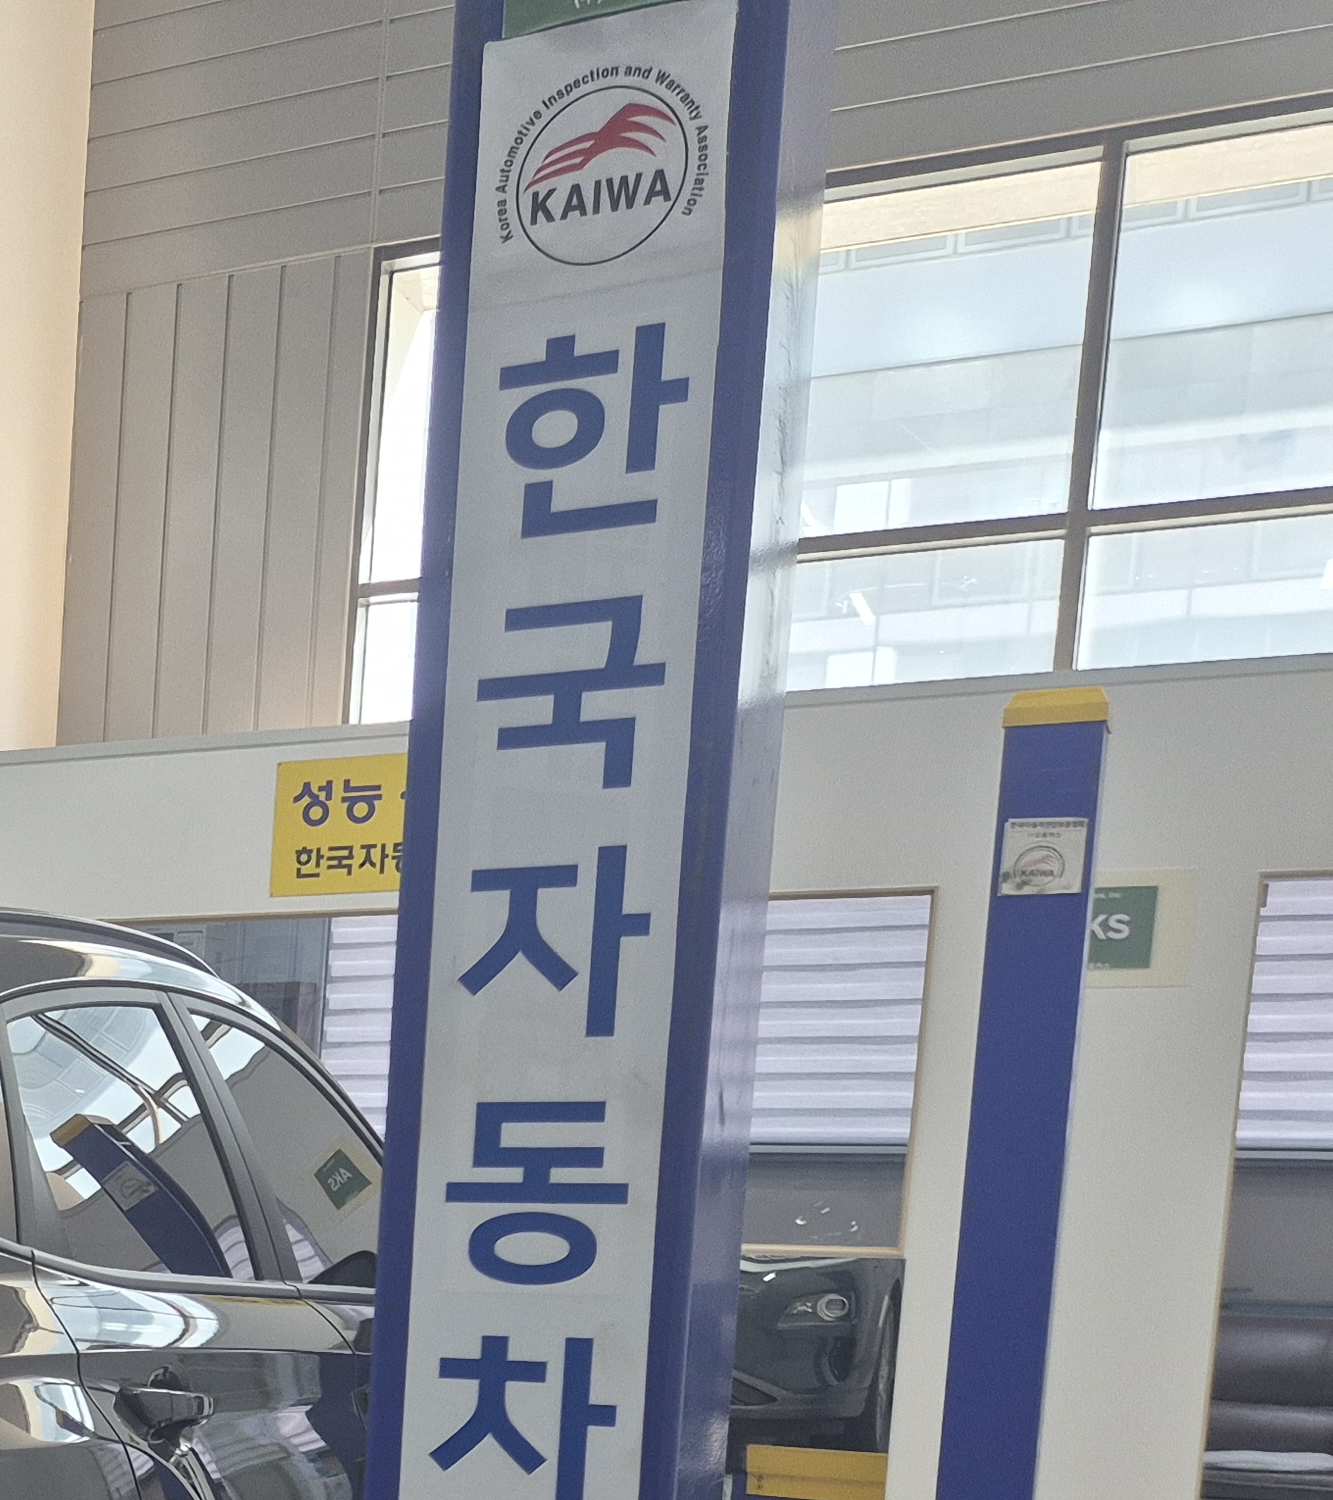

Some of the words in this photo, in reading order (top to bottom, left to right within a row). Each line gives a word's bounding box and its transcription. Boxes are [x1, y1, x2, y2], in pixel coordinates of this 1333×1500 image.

[542, 65, 620, 110] Inspection
[624, 65, 654, 80] and
[655, 69, 703, 122] Warranty
[495, 110, 543, 194] Automotive
[682, 124, 710, 217] Association
[496, 198, 514, 243] Korea
[530, 168, 672, 227] KAIWA
[293, 779, 383, 827] 성능
